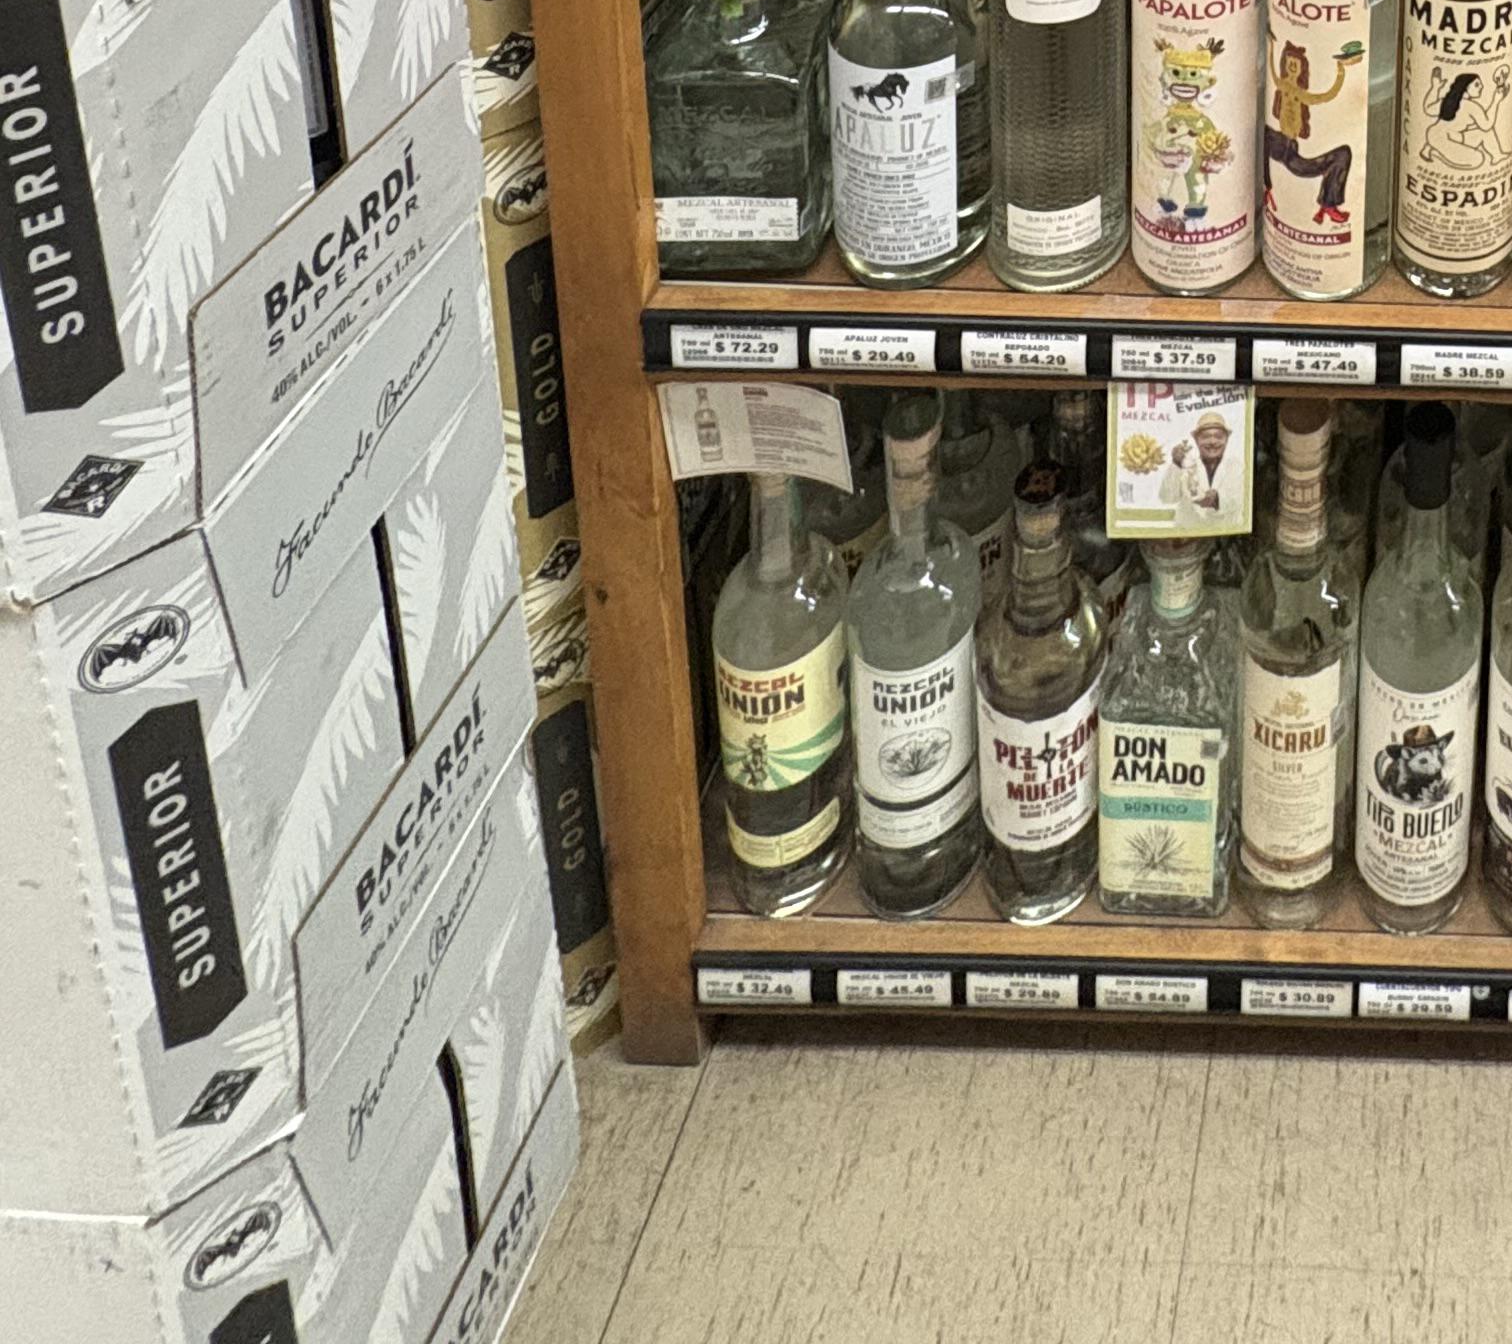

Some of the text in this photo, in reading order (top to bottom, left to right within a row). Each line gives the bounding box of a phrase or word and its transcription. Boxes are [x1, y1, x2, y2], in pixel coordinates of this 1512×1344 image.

[0, 64, 85, 346] SUPERIOR
[264, 139, 416, 329] BACARDÍ
[267, 194, 420, 356] SUPERIOR
[530, 331, 564, 426] GOLD
[1154, 353, 1216, 366] $ 37.59
[872, 666, 954, 694] MEZCAL
[1111, 761, 1205, 787] AMADO
[1112, 735, 1167, 761] DON
[1252, 720, 1327, 754] XICARU
[356, 682, 483, 915] BACARDÍ
[144, 761, 216, 989] SUPERIOR
